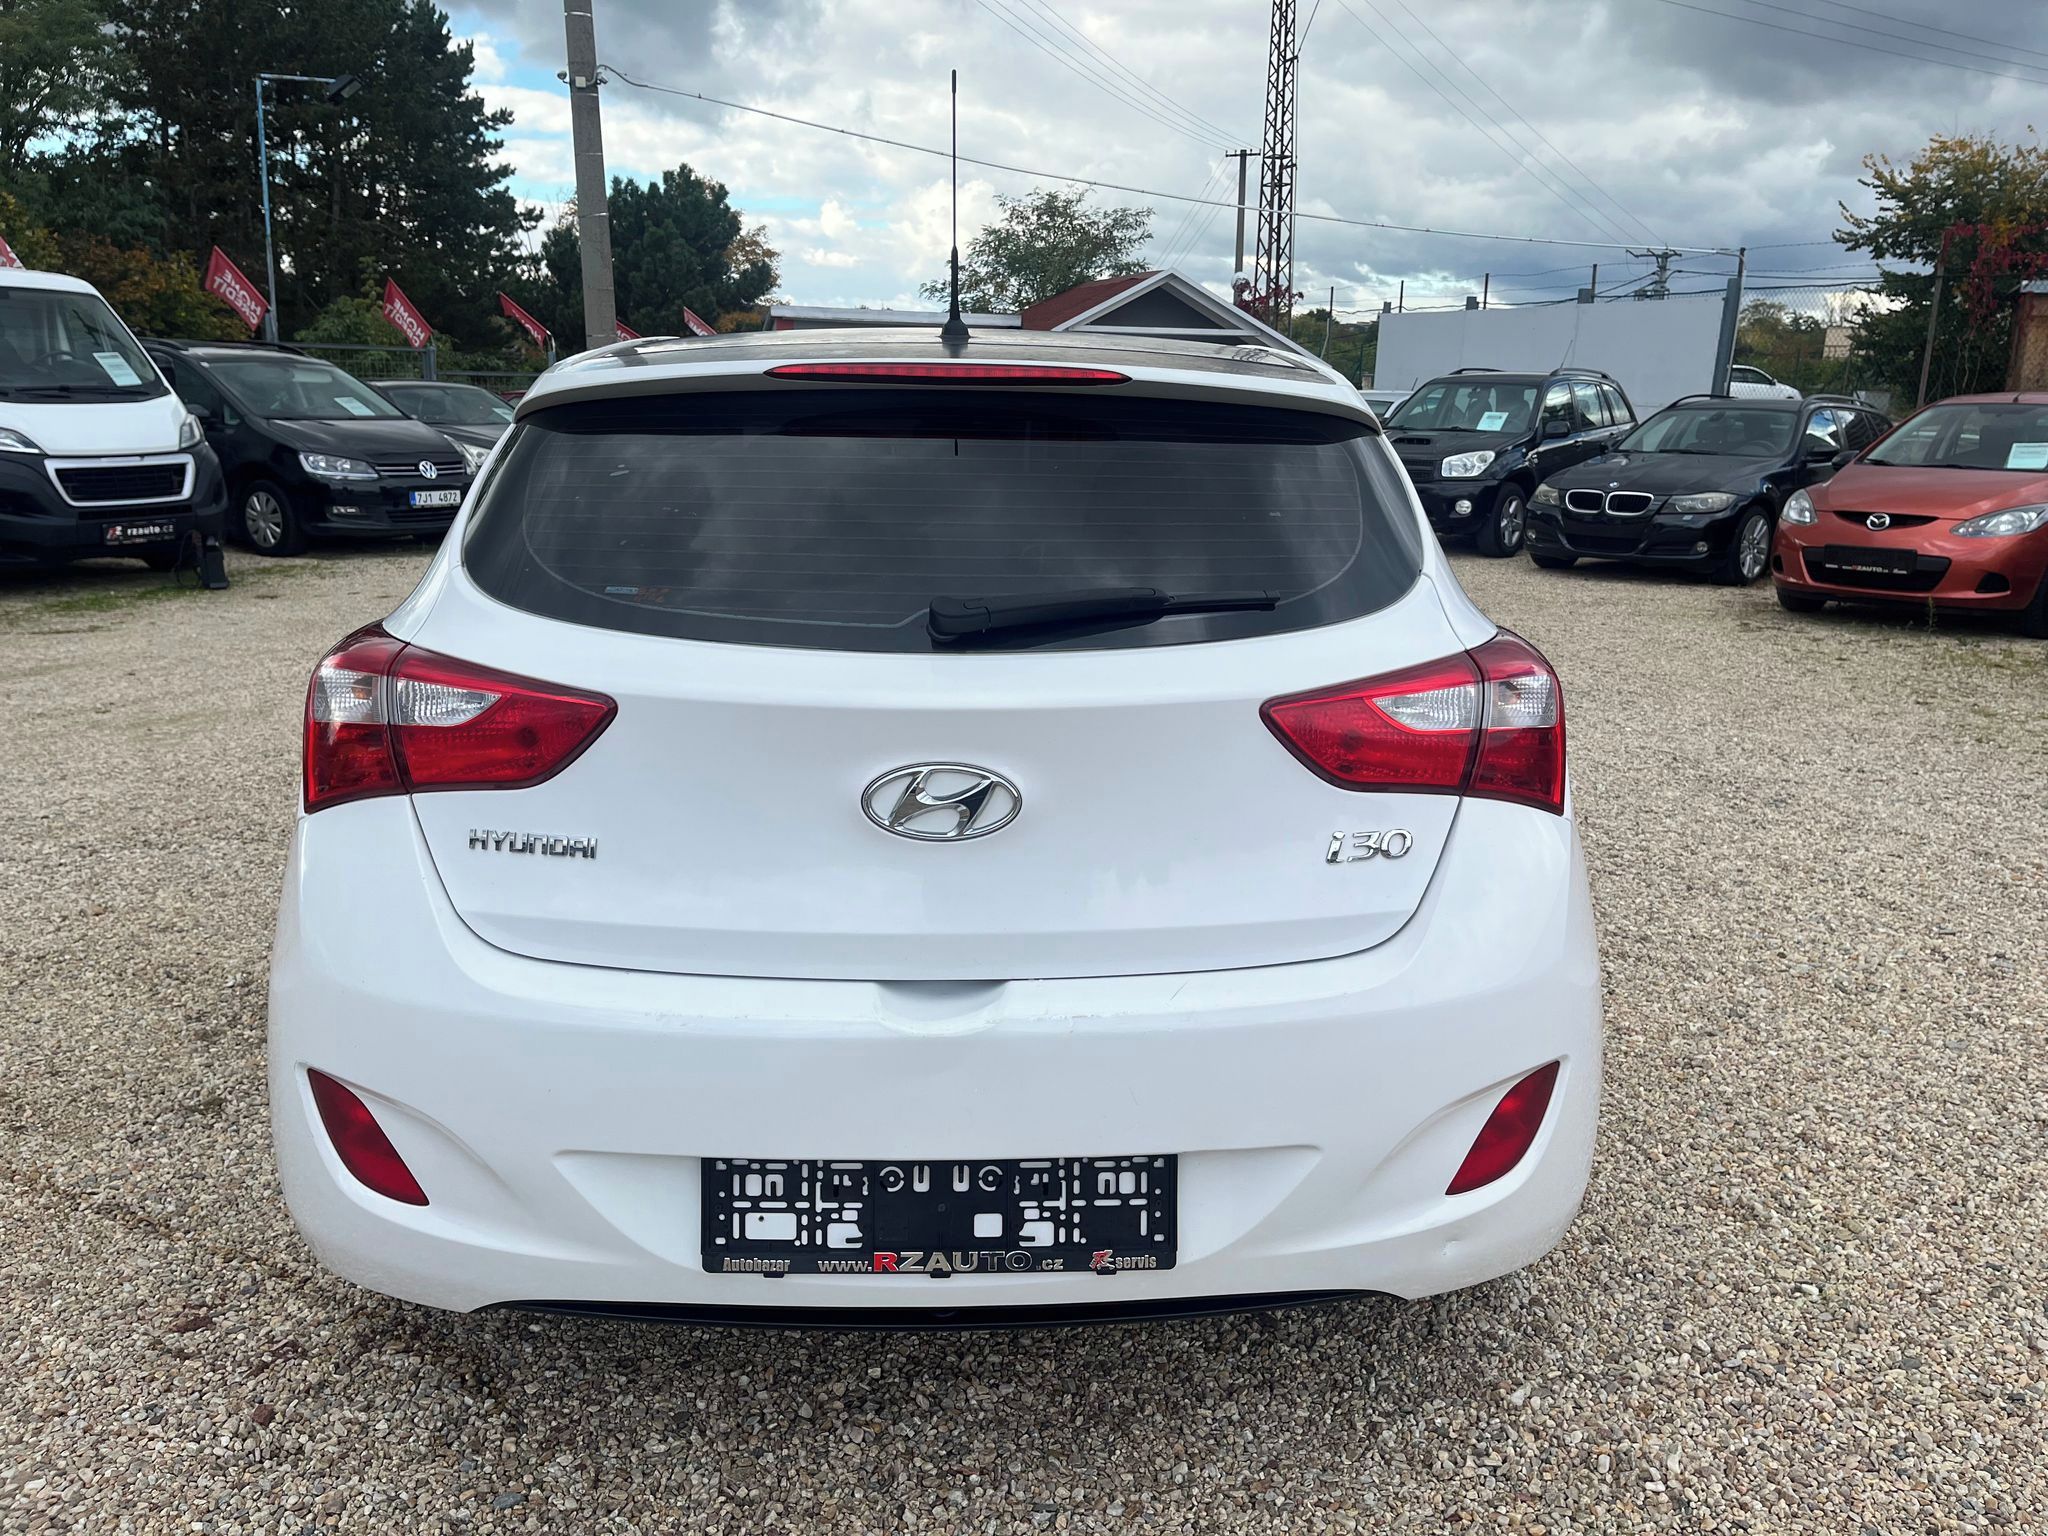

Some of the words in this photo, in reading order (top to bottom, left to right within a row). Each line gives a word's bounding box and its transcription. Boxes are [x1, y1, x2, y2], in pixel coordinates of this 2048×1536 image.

[417, 493, 433, 504] 7J1
[438, 491, 458, 503] 4872
[468, 828, 598, 859] HYUNDAI
[1325, 828, 1414, 865] i30
[722, 1257, 791, 1273] Autobazar
[1115, 1254, 1157, 1270] servis
